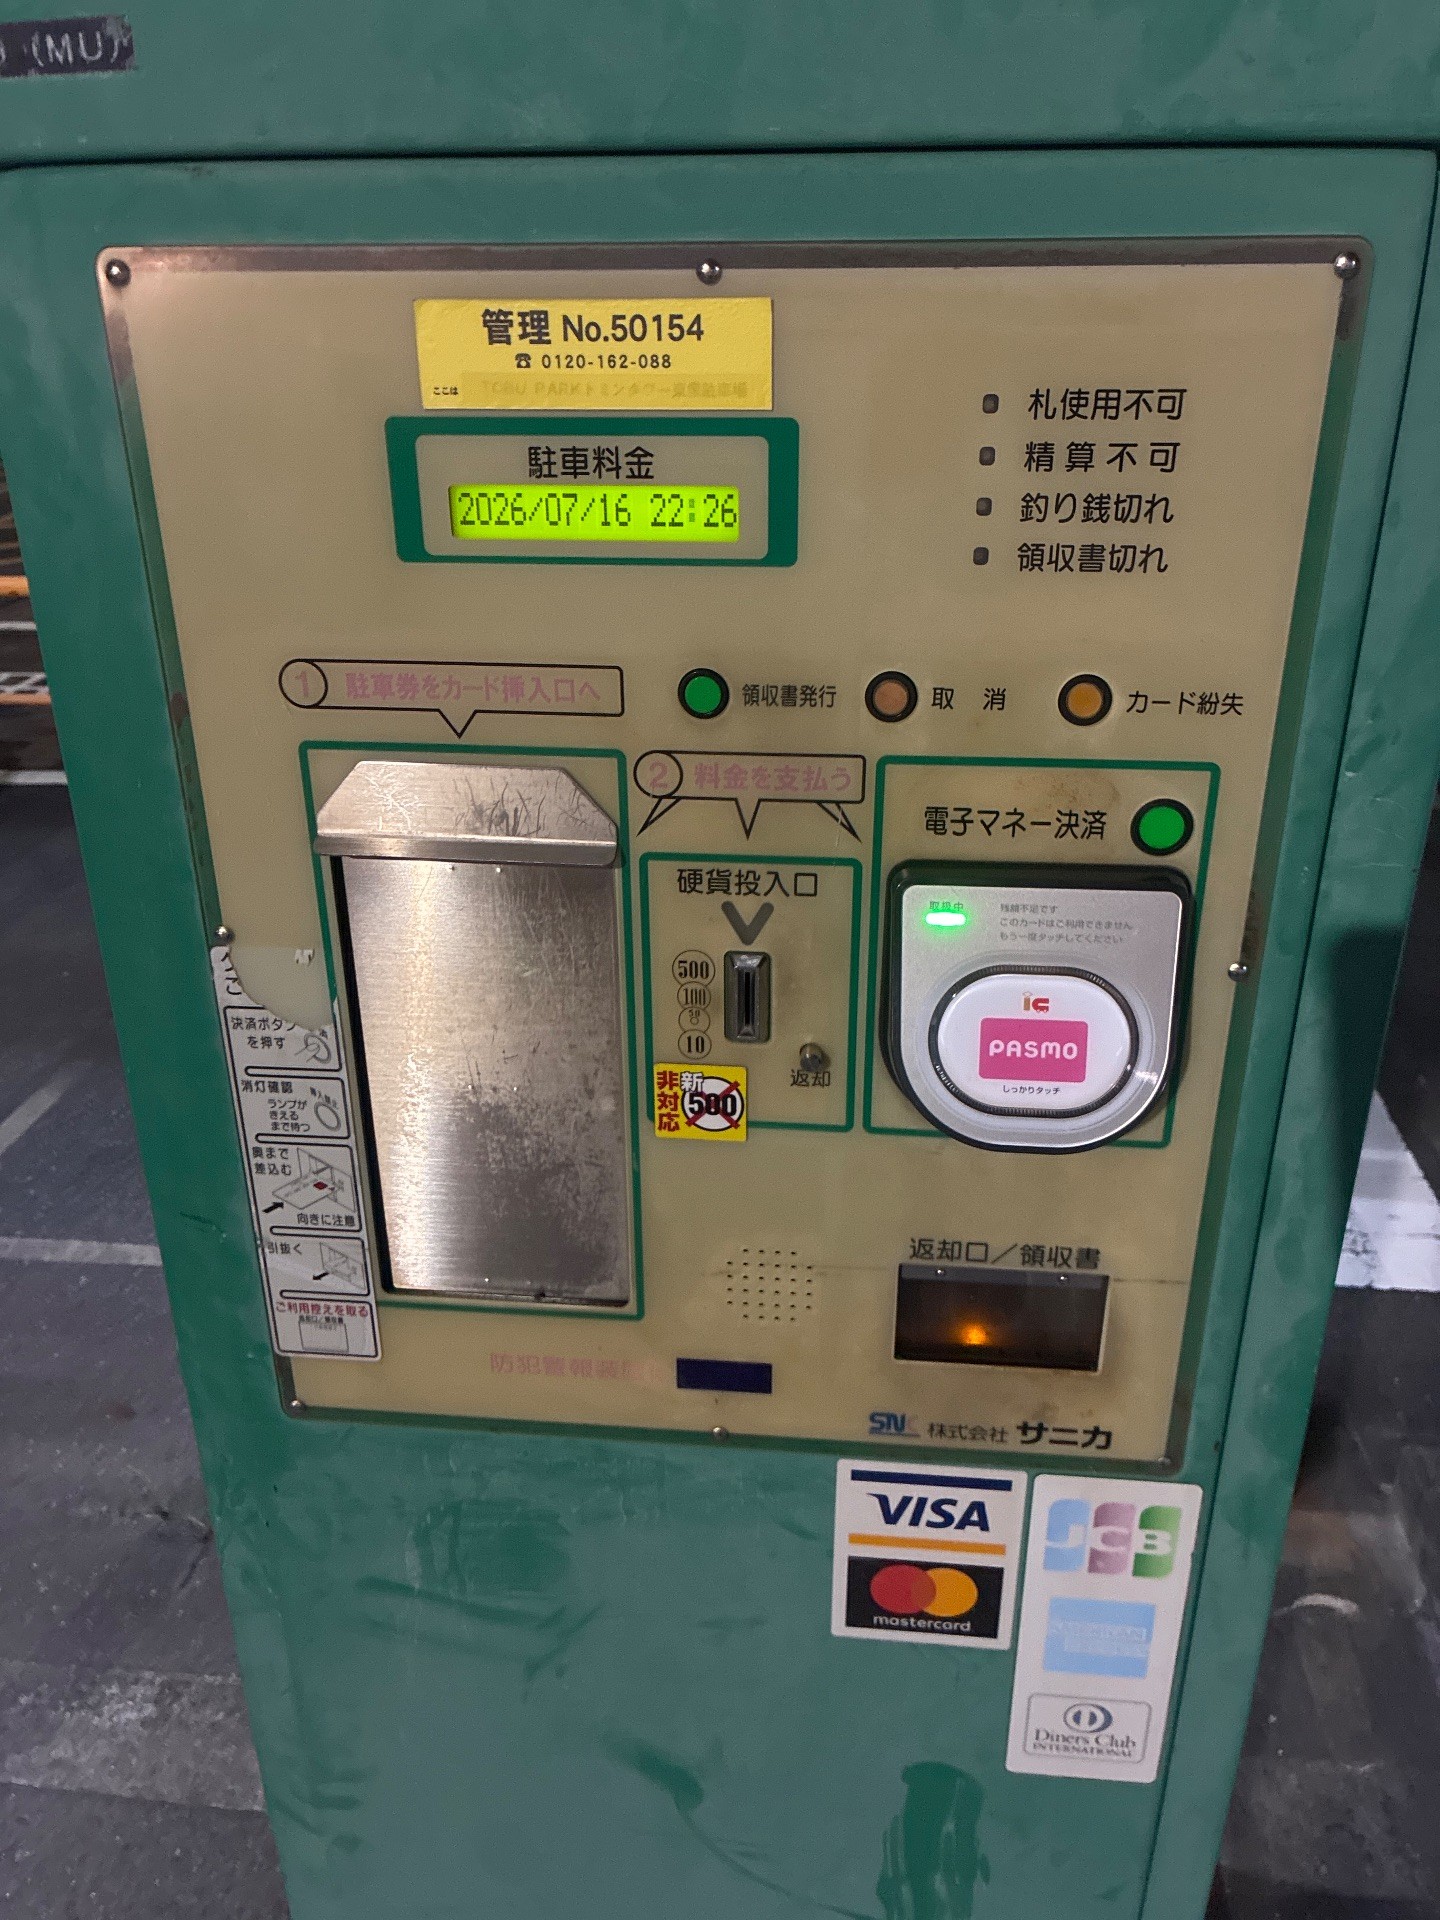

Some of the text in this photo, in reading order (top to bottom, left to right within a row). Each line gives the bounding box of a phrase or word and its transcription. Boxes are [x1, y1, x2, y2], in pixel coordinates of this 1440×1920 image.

[481, 308, 705, 346] 管理 No.50154
[541, 354, 672, 370] 0120-162-088
[433, 386, 459, 397] ここは
[1028, 388, 1187, 420] 札使用不可
[528, 446, 655, 480] 駐車料金
[1023, 441, 1181, 473] 精算不可
[457, 492, 738, 528] 2026/07/16 22:26
[1019, 492, 1174, 524] 釣り銭切れ
[1017, 542, 1168, 574] 領収書切れ
[345, 672, 601, 703] 駐車券をカード挿入口へ
[742, 684, 837, 709] 領収書発行
[1126, 691, 1244, 716] カード紛失
[649, 761, 851, 792] 2 料金を支払う
[924, 806, 1107, 840] 電子マネー決済
[677, 868, 818, 898] 硬貨投入口
[678, 960, 710, 980] 500
[683, 988, 707, 1006] 100
[248, 1036, 285, 1050] を押す
[687, 1035, 705, 1054] 10
[989, 1038, 1078, 1060] PASMO
[790, 1069, 831, 1088] 返却
[1002, 1084, 1061, 1095] しっかりタッチ
[656, 1070, 681, 1132] 非対応
[688, 1092, 738, 1117] 500
[297, 1213, 355, 1227] 向きに注意
[927, 1422, 1009, 1443] 株式会社
[1016, 1421, 1112, 1449] サニカ
[866, 1493, 990, 1532] VISA
[873, 1615, 971, 1632] mastercard
[1035, 1728, 1136, 1749] Diners Club
